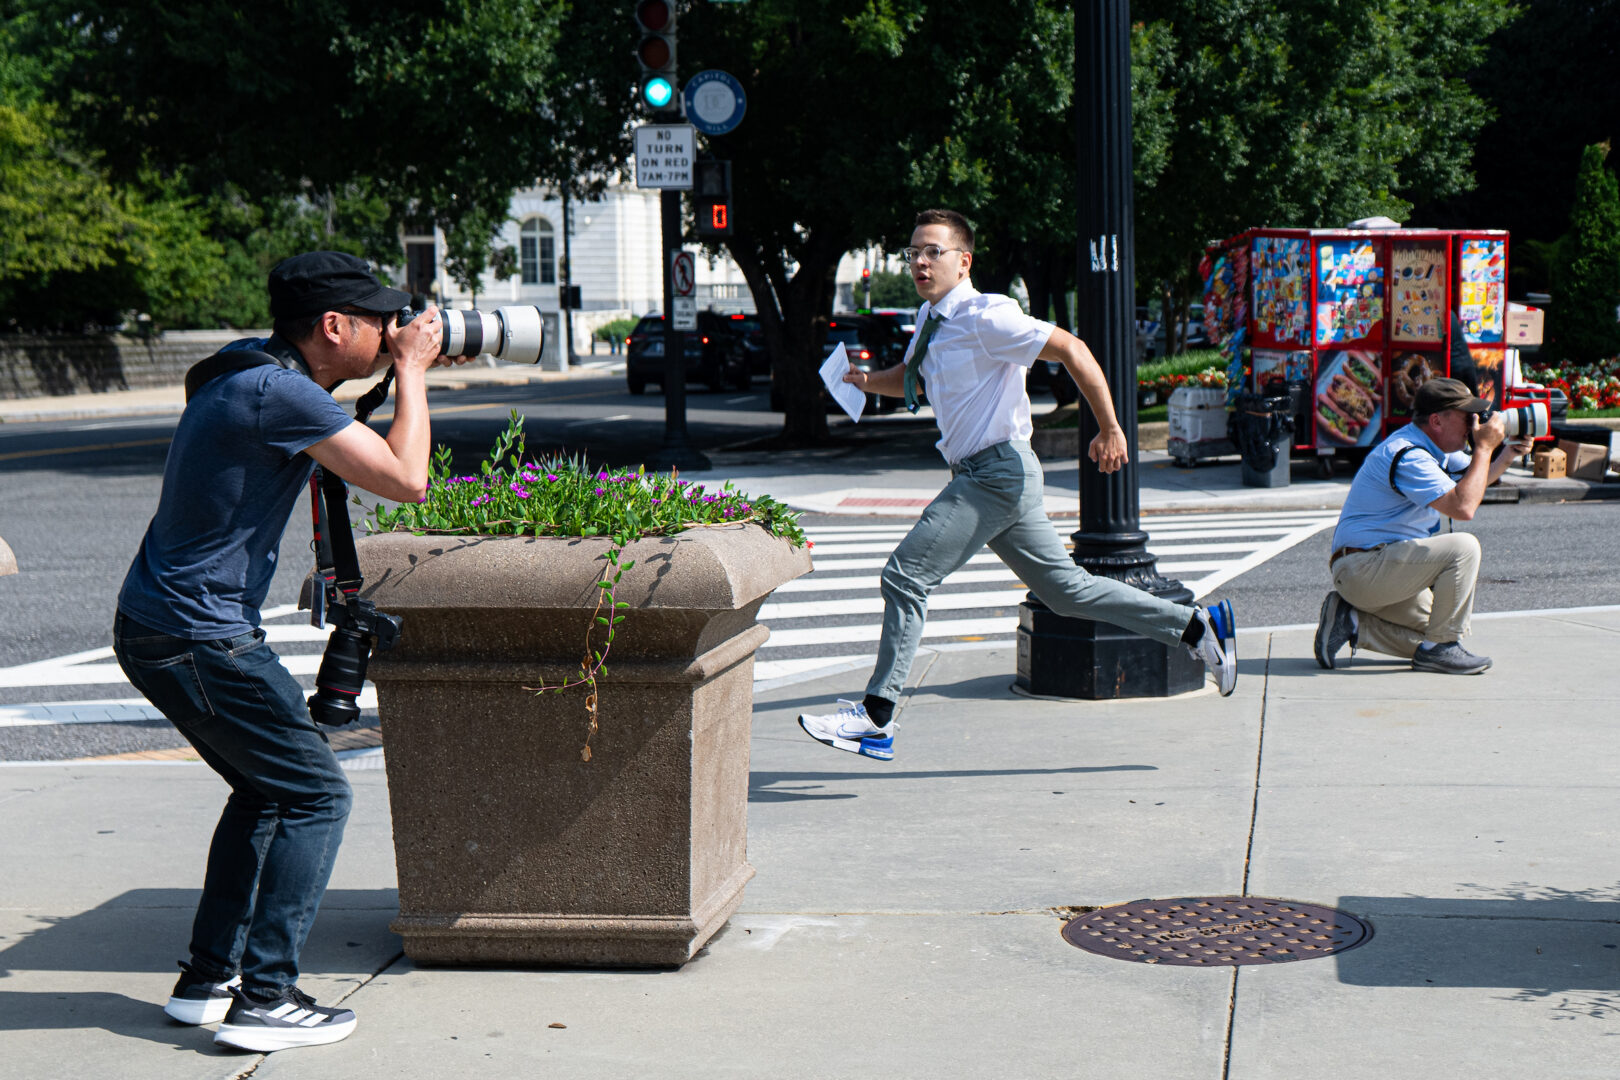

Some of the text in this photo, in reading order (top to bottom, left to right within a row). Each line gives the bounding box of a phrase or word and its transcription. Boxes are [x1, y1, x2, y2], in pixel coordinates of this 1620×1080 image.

[656, 130, 672, 140] NO
[646, 144, 684, 154] TURN
[641, 158, 689, 168] ON RED
[641, 172, 689, 181] 7AM-7PM
[712, 204, 727, 229] 0
